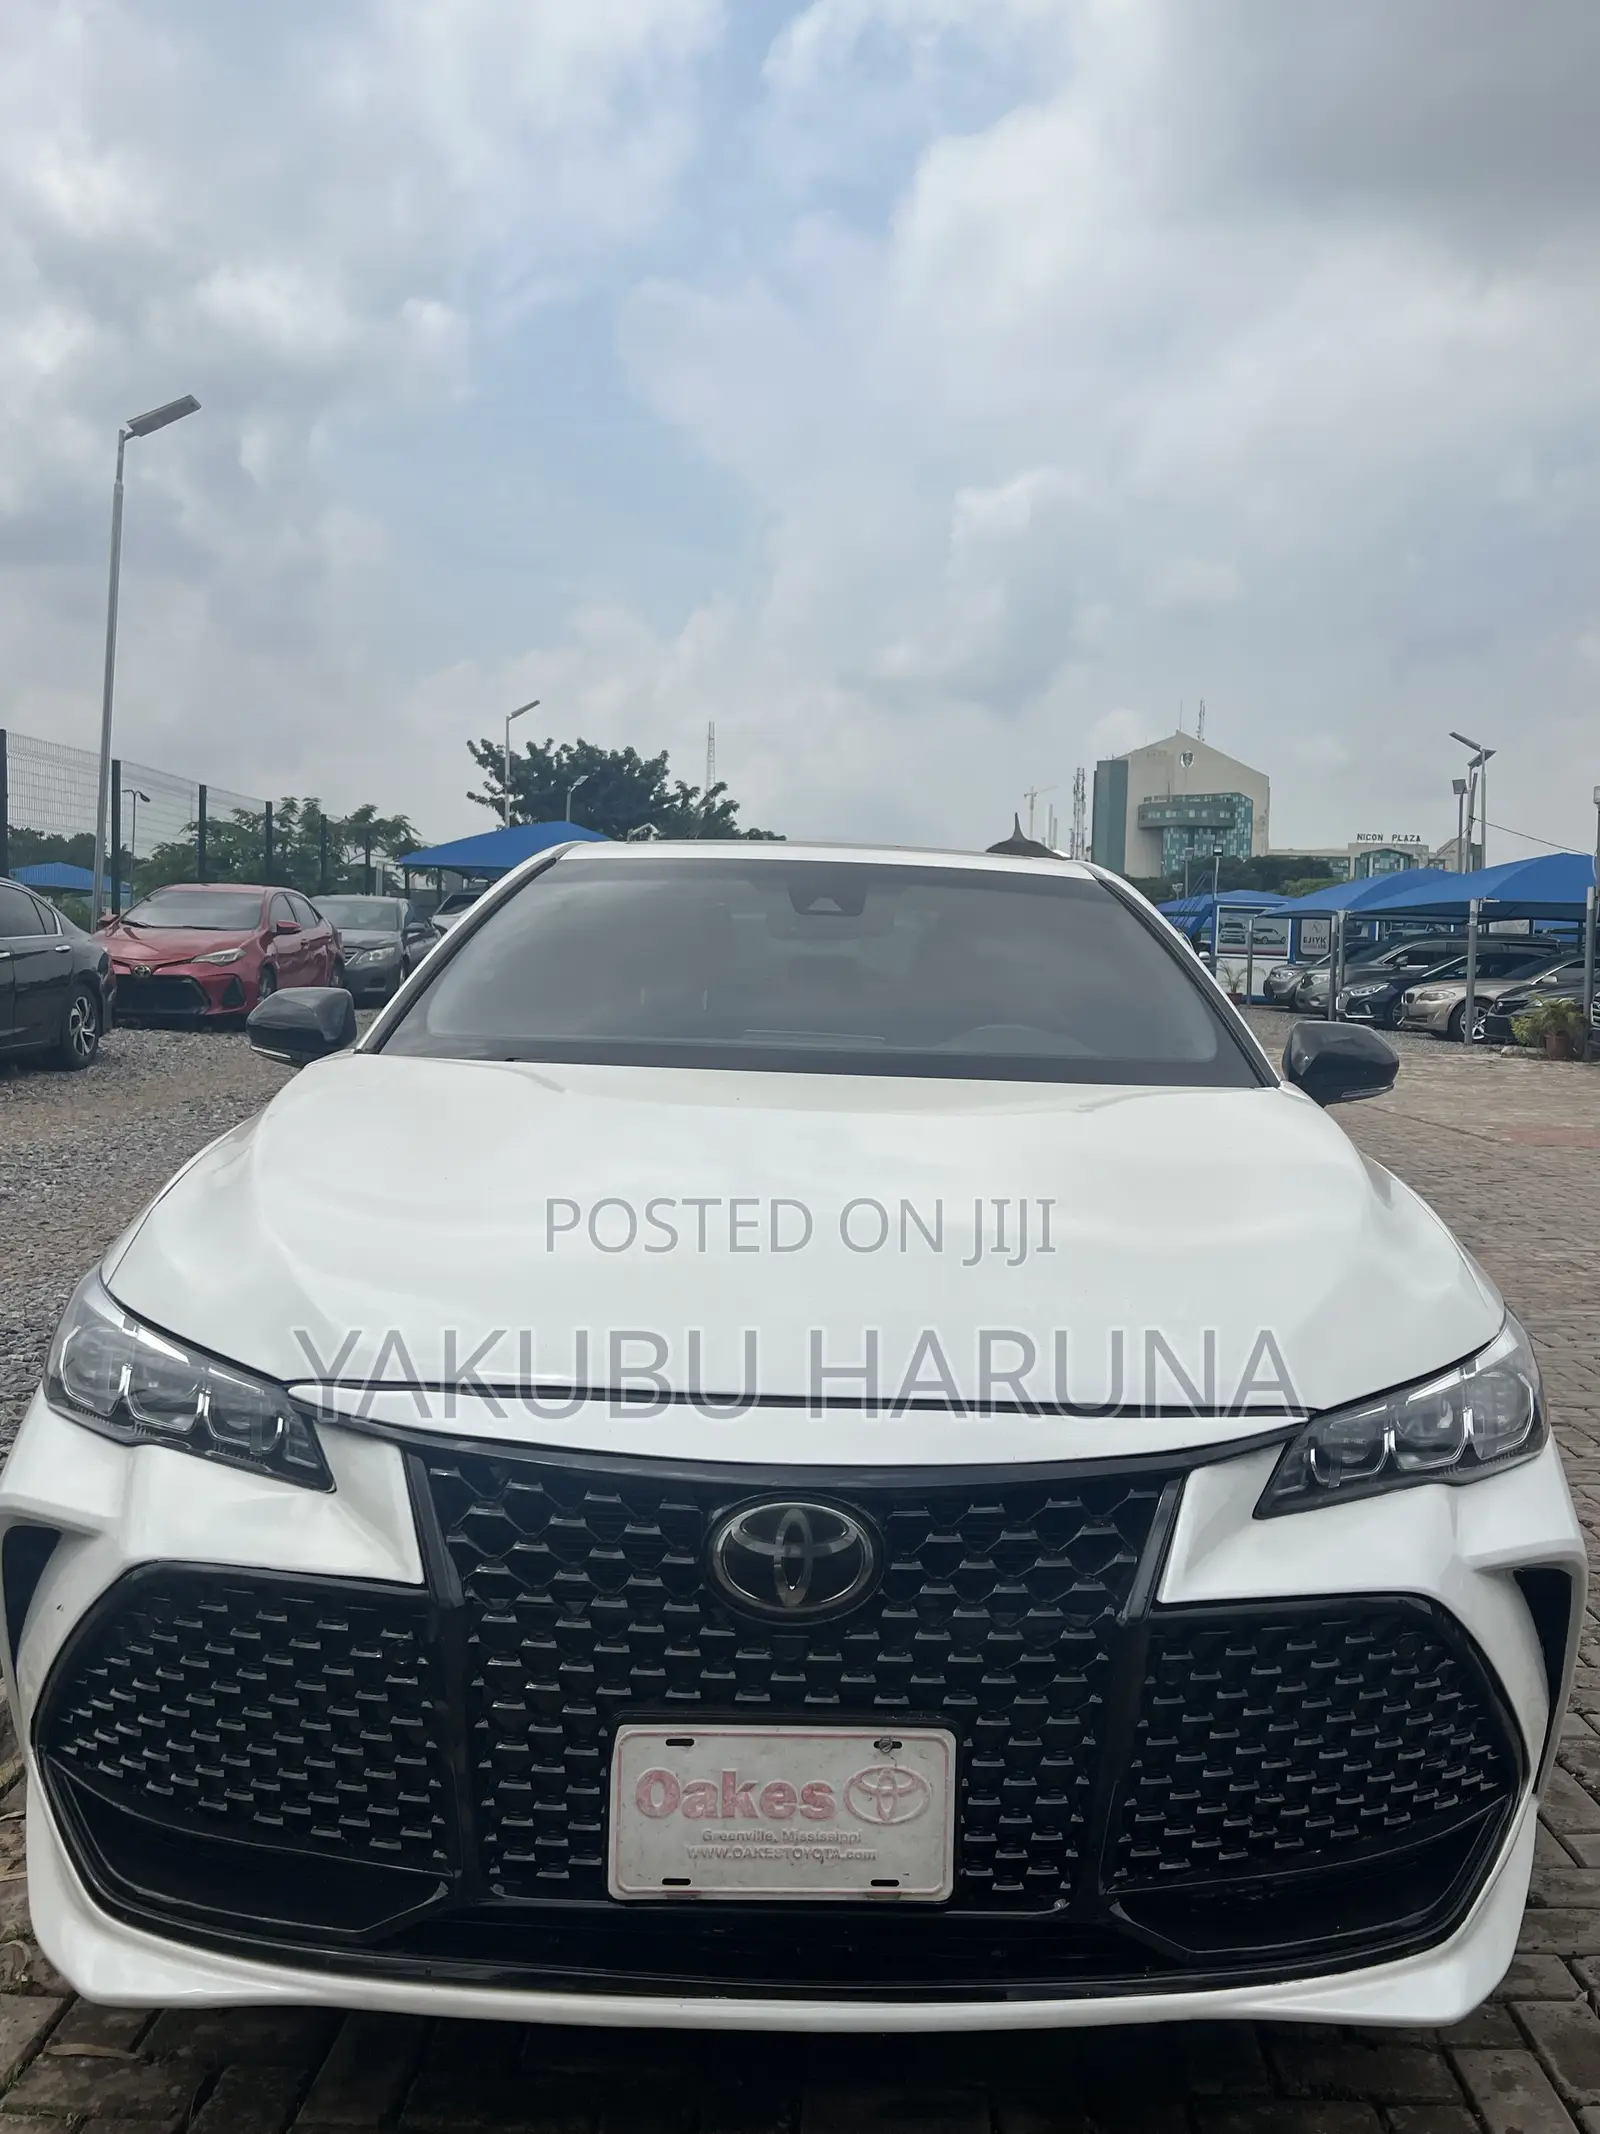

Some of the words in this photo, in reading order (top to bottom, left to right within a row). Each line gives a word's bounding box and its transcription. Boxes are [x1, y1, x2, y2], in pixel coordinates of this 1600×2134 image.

[1356, 833, 1383, 841] NICON
[1391, 834, 1421, 842] PLAZA
[635, 1767, 838, 1820] Oakes
[702, 1829, 778, 1844] Greenville,
[782, 1829, 862, 1845] Mississippi
